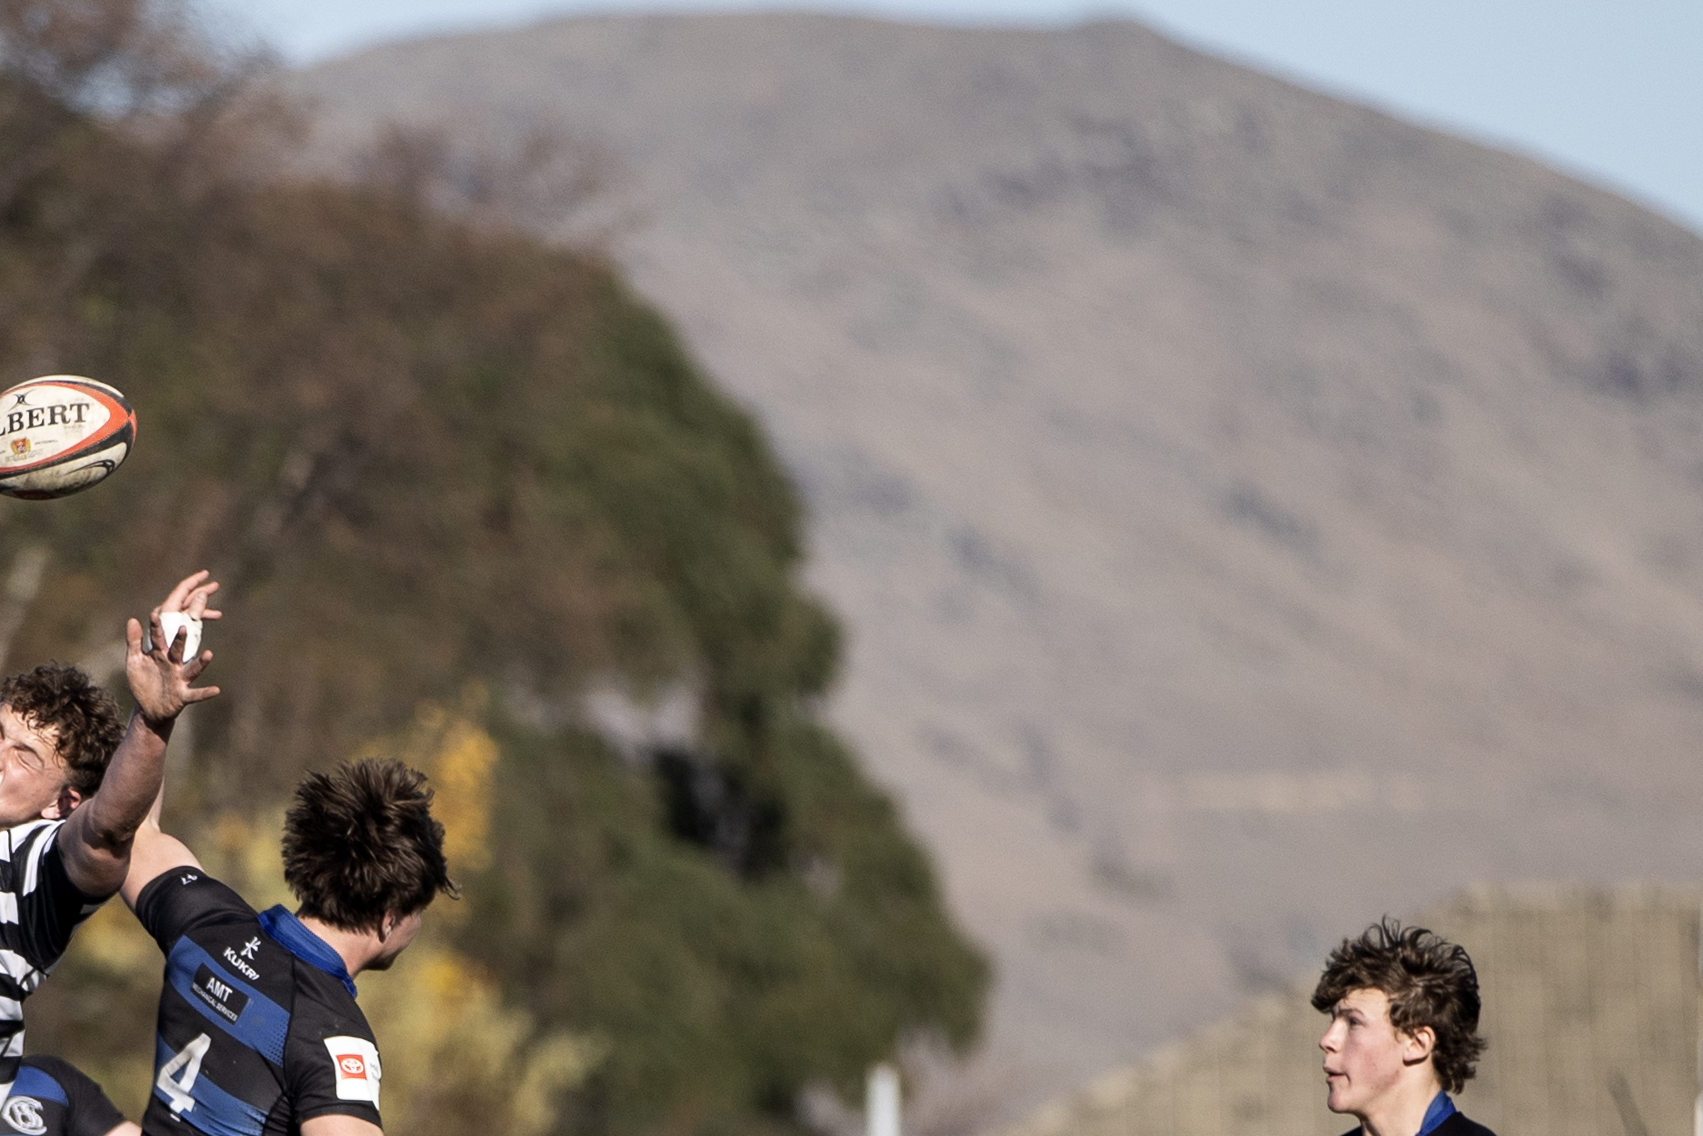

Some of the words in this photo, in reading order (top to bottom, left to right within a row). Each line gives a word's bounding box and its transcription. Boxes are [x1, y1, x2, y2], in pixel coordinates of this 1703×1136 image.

[223, 947, 260, 981] KUKRI
[206, 976, 233, 1002] AMT
[157, 1032, 211, 1114] 4
